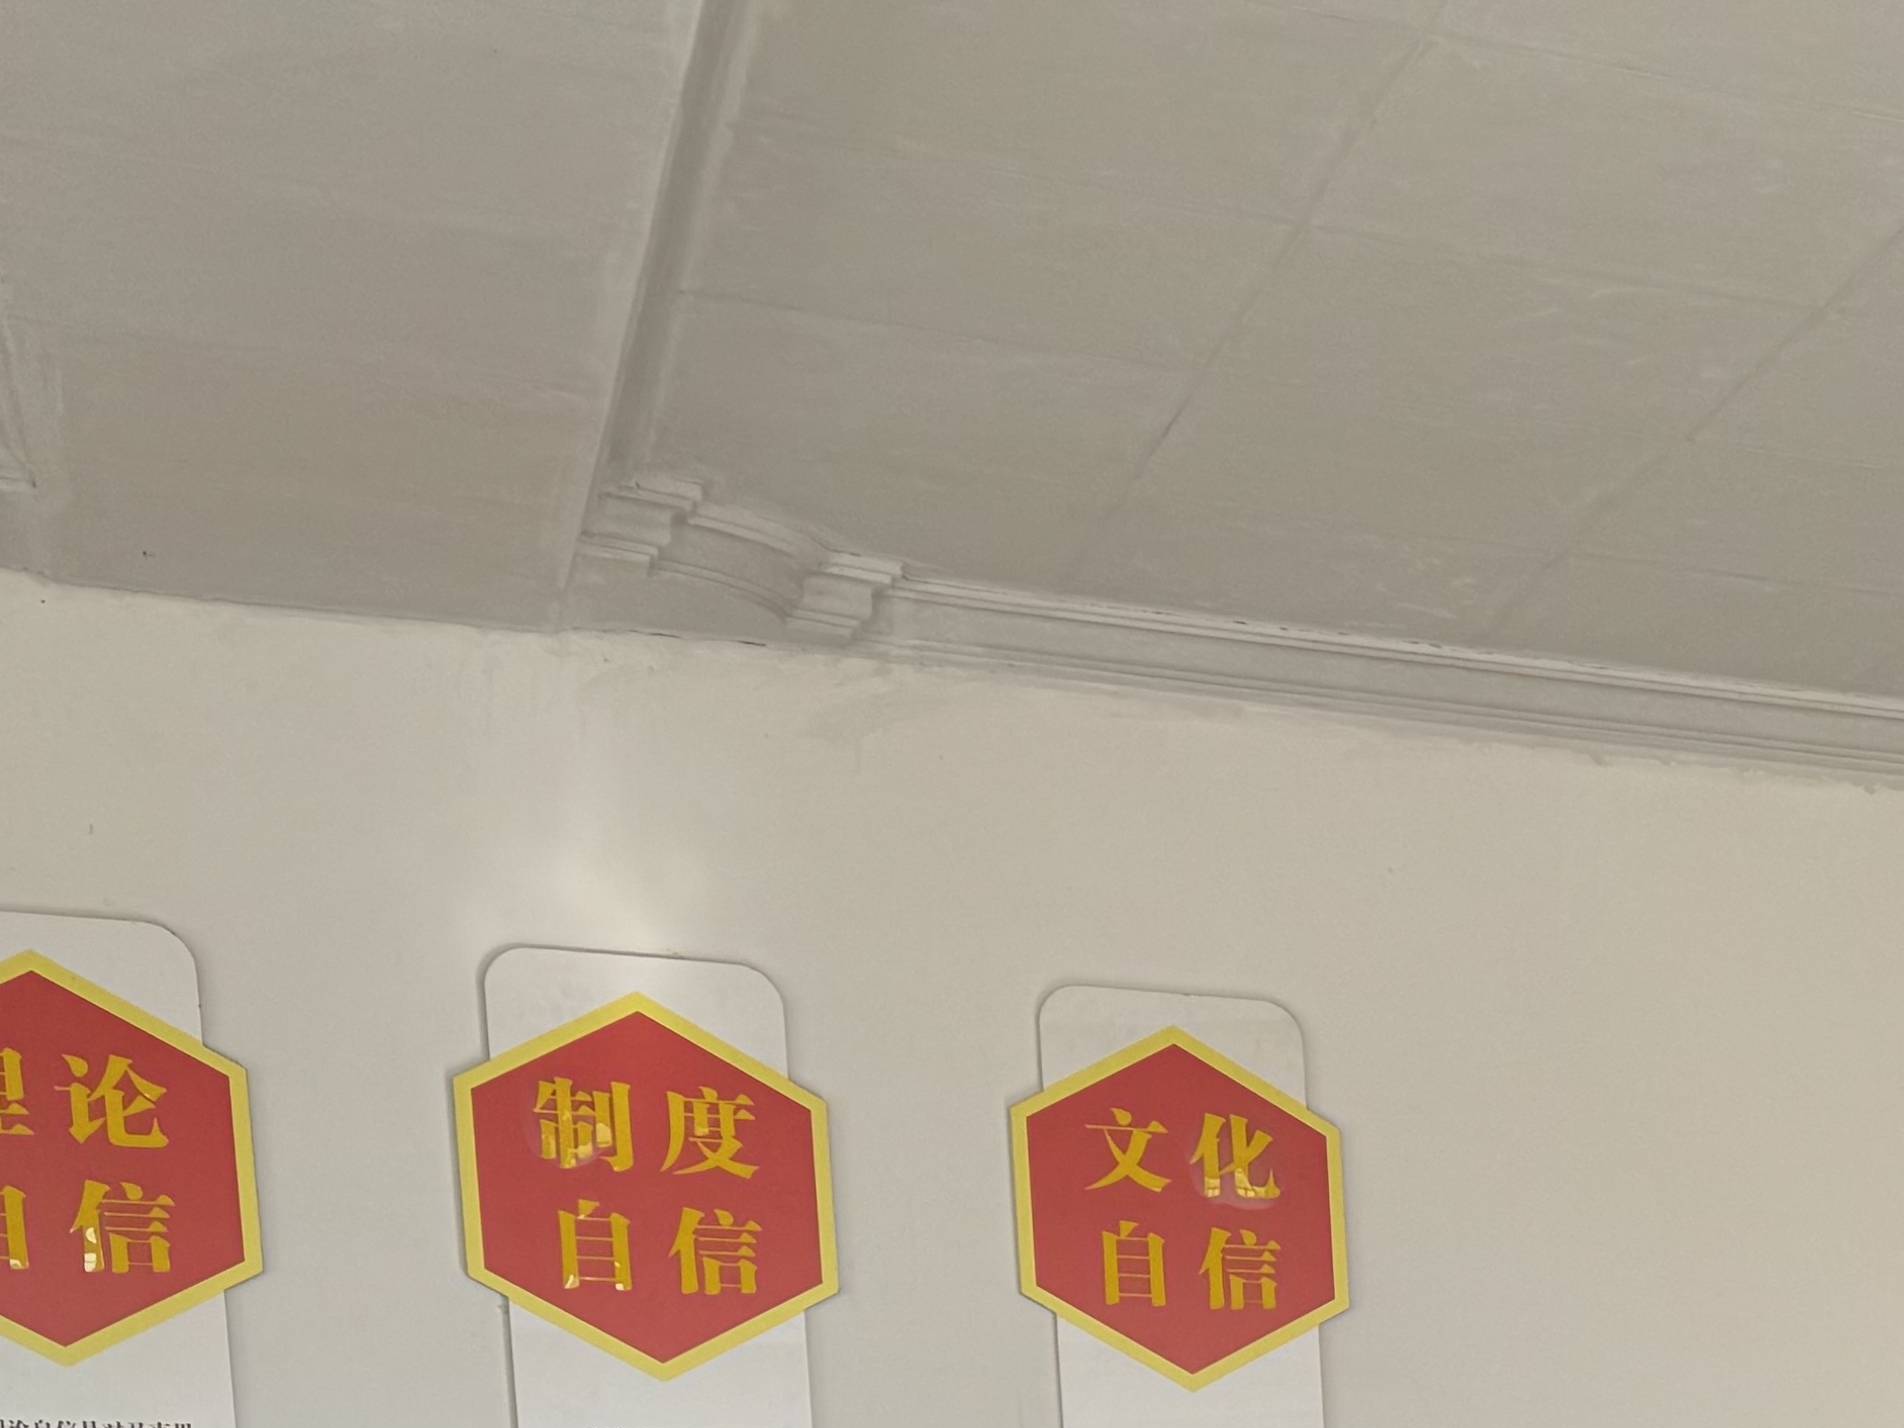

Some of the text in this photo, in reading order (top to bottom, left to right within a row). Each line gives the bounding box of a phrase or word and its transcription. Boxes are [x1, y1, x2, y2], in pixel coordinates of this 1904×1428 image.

[533, 1077, 760, 1180] 制度
[1085, 1107, 1281, 1200] 文化
[558, 1199, 762, 1295] 自信
[1102, 1220, 1281, 1310] 自信
